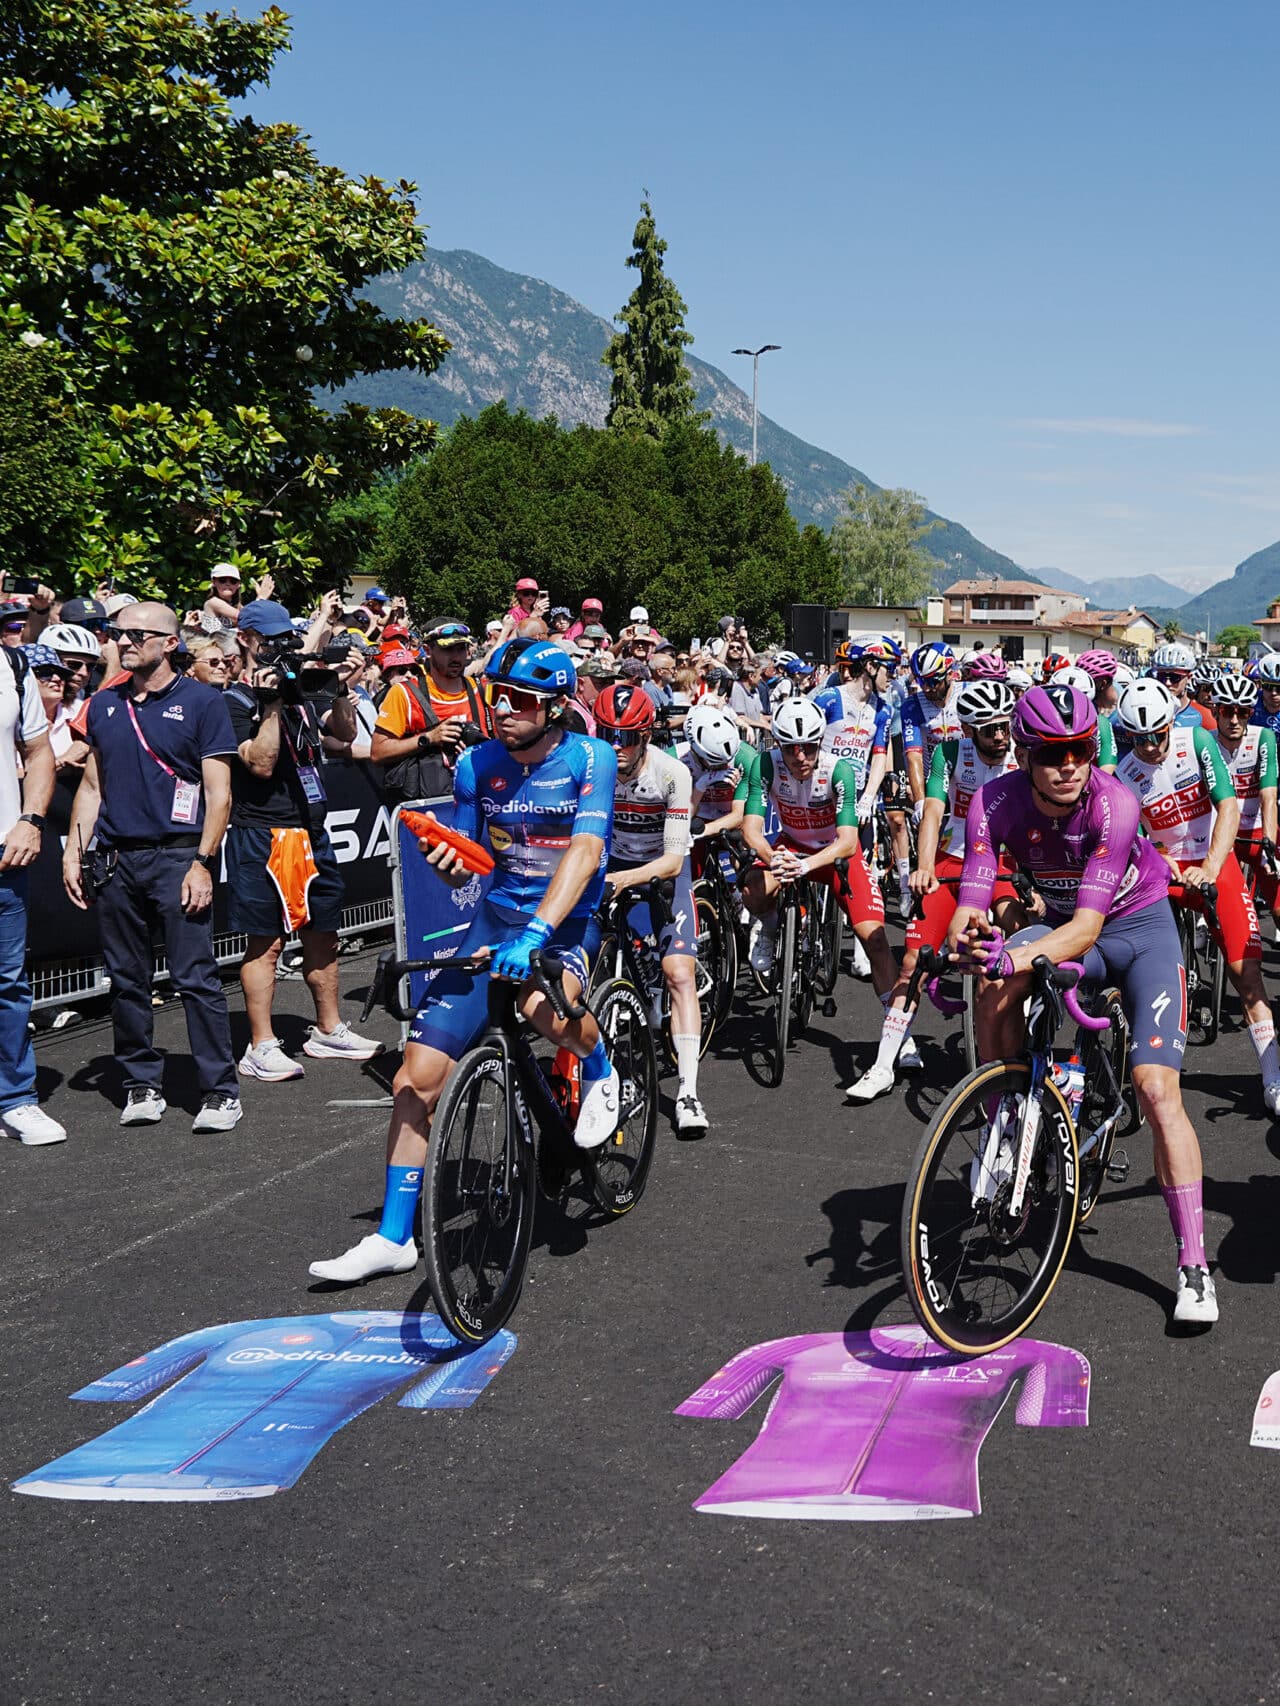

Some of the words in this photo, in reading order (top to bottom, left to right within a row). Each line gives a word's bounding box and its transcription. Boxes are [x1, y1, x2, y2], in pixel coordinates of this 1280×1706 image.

[580, 740, 596, 780] CASTELLI
[1201, 747, 1217, 791] KOMETA
[978, 791, 1007, 837] CASTELLI
[1100, 795, 1112, 842] CASTELLI
[1053, 1111, 1075, 1195] roval
[919, 1222, 946, 1314] roval
[226, 1347, 432, 1366] mediolanum
